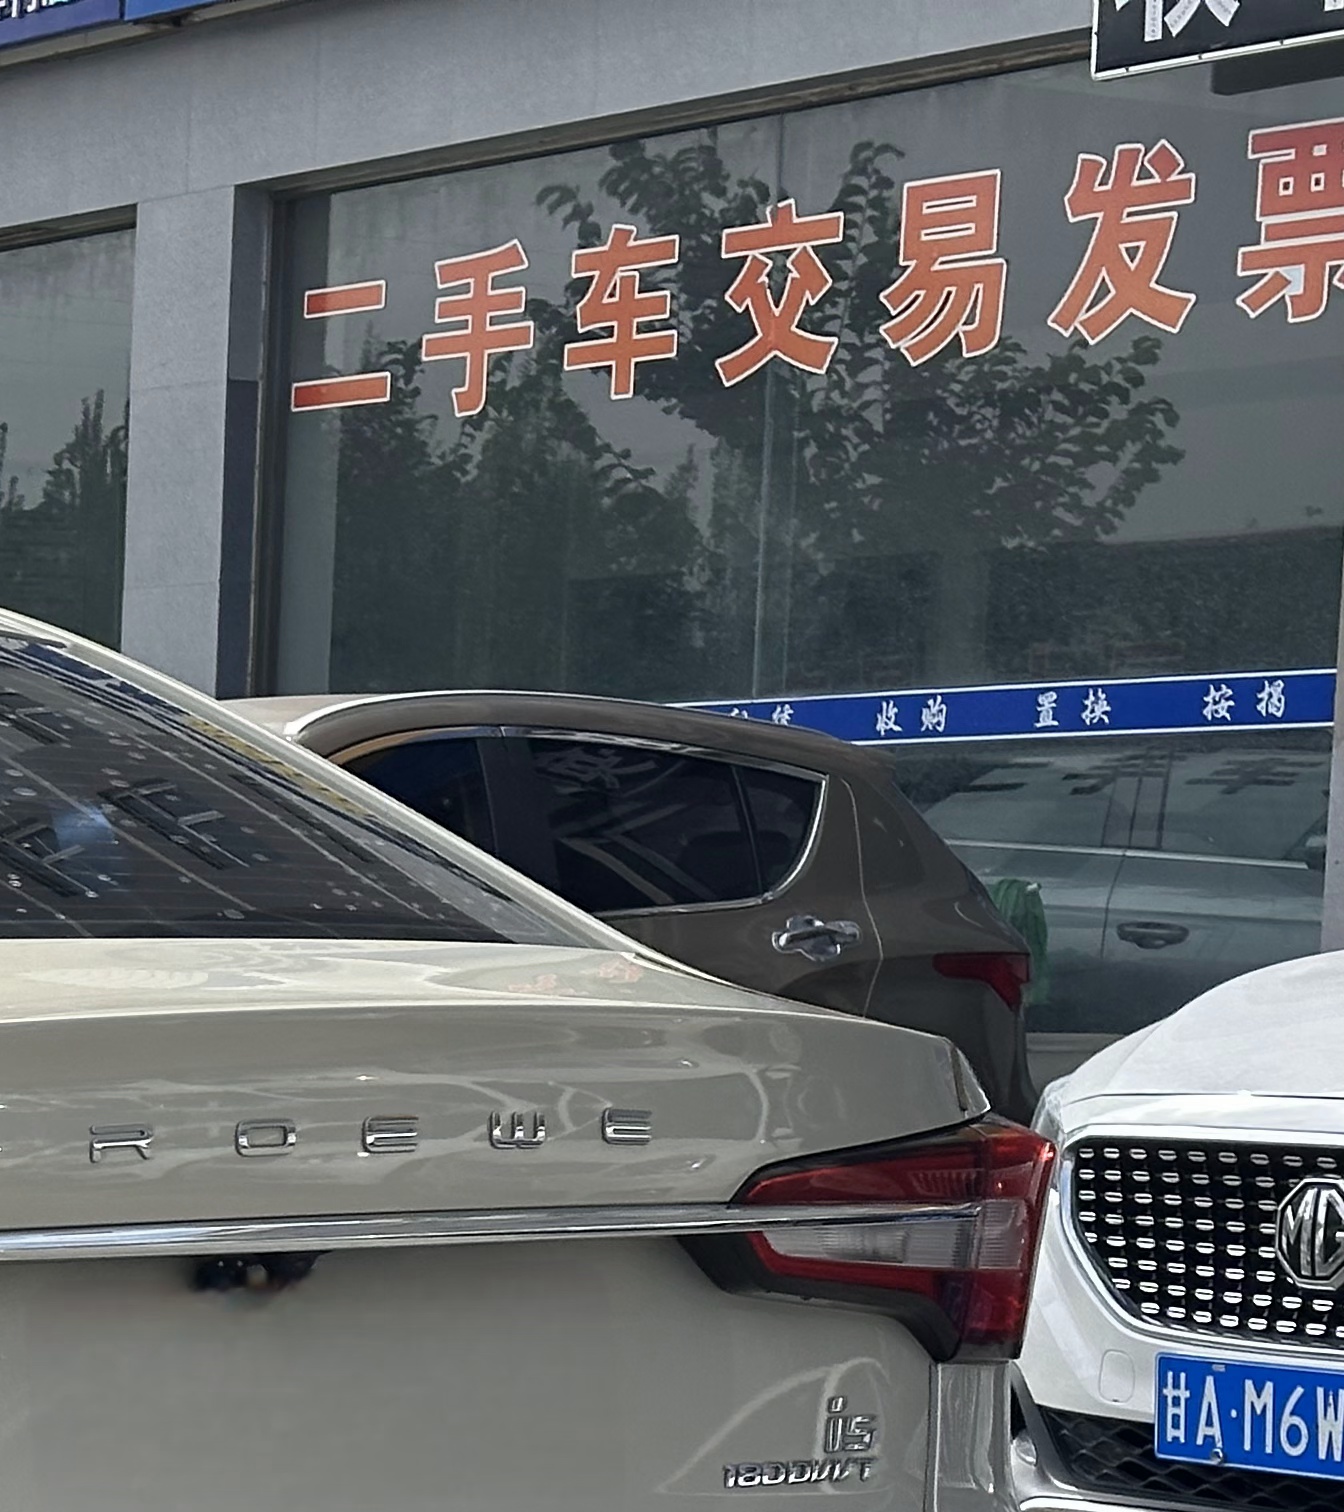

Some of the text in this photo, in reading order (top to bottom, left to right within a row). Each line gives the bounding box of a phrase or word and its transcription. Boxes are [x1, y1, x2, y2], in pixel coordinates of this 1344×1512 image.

[290, 117, 1344, 418] 二手车交易发票
[874, 679, 1286, 737] 收购 置换 按揭
[89, 1107, 652, 1164] ROEWE
[823, 1396, 877, 1454] i5
